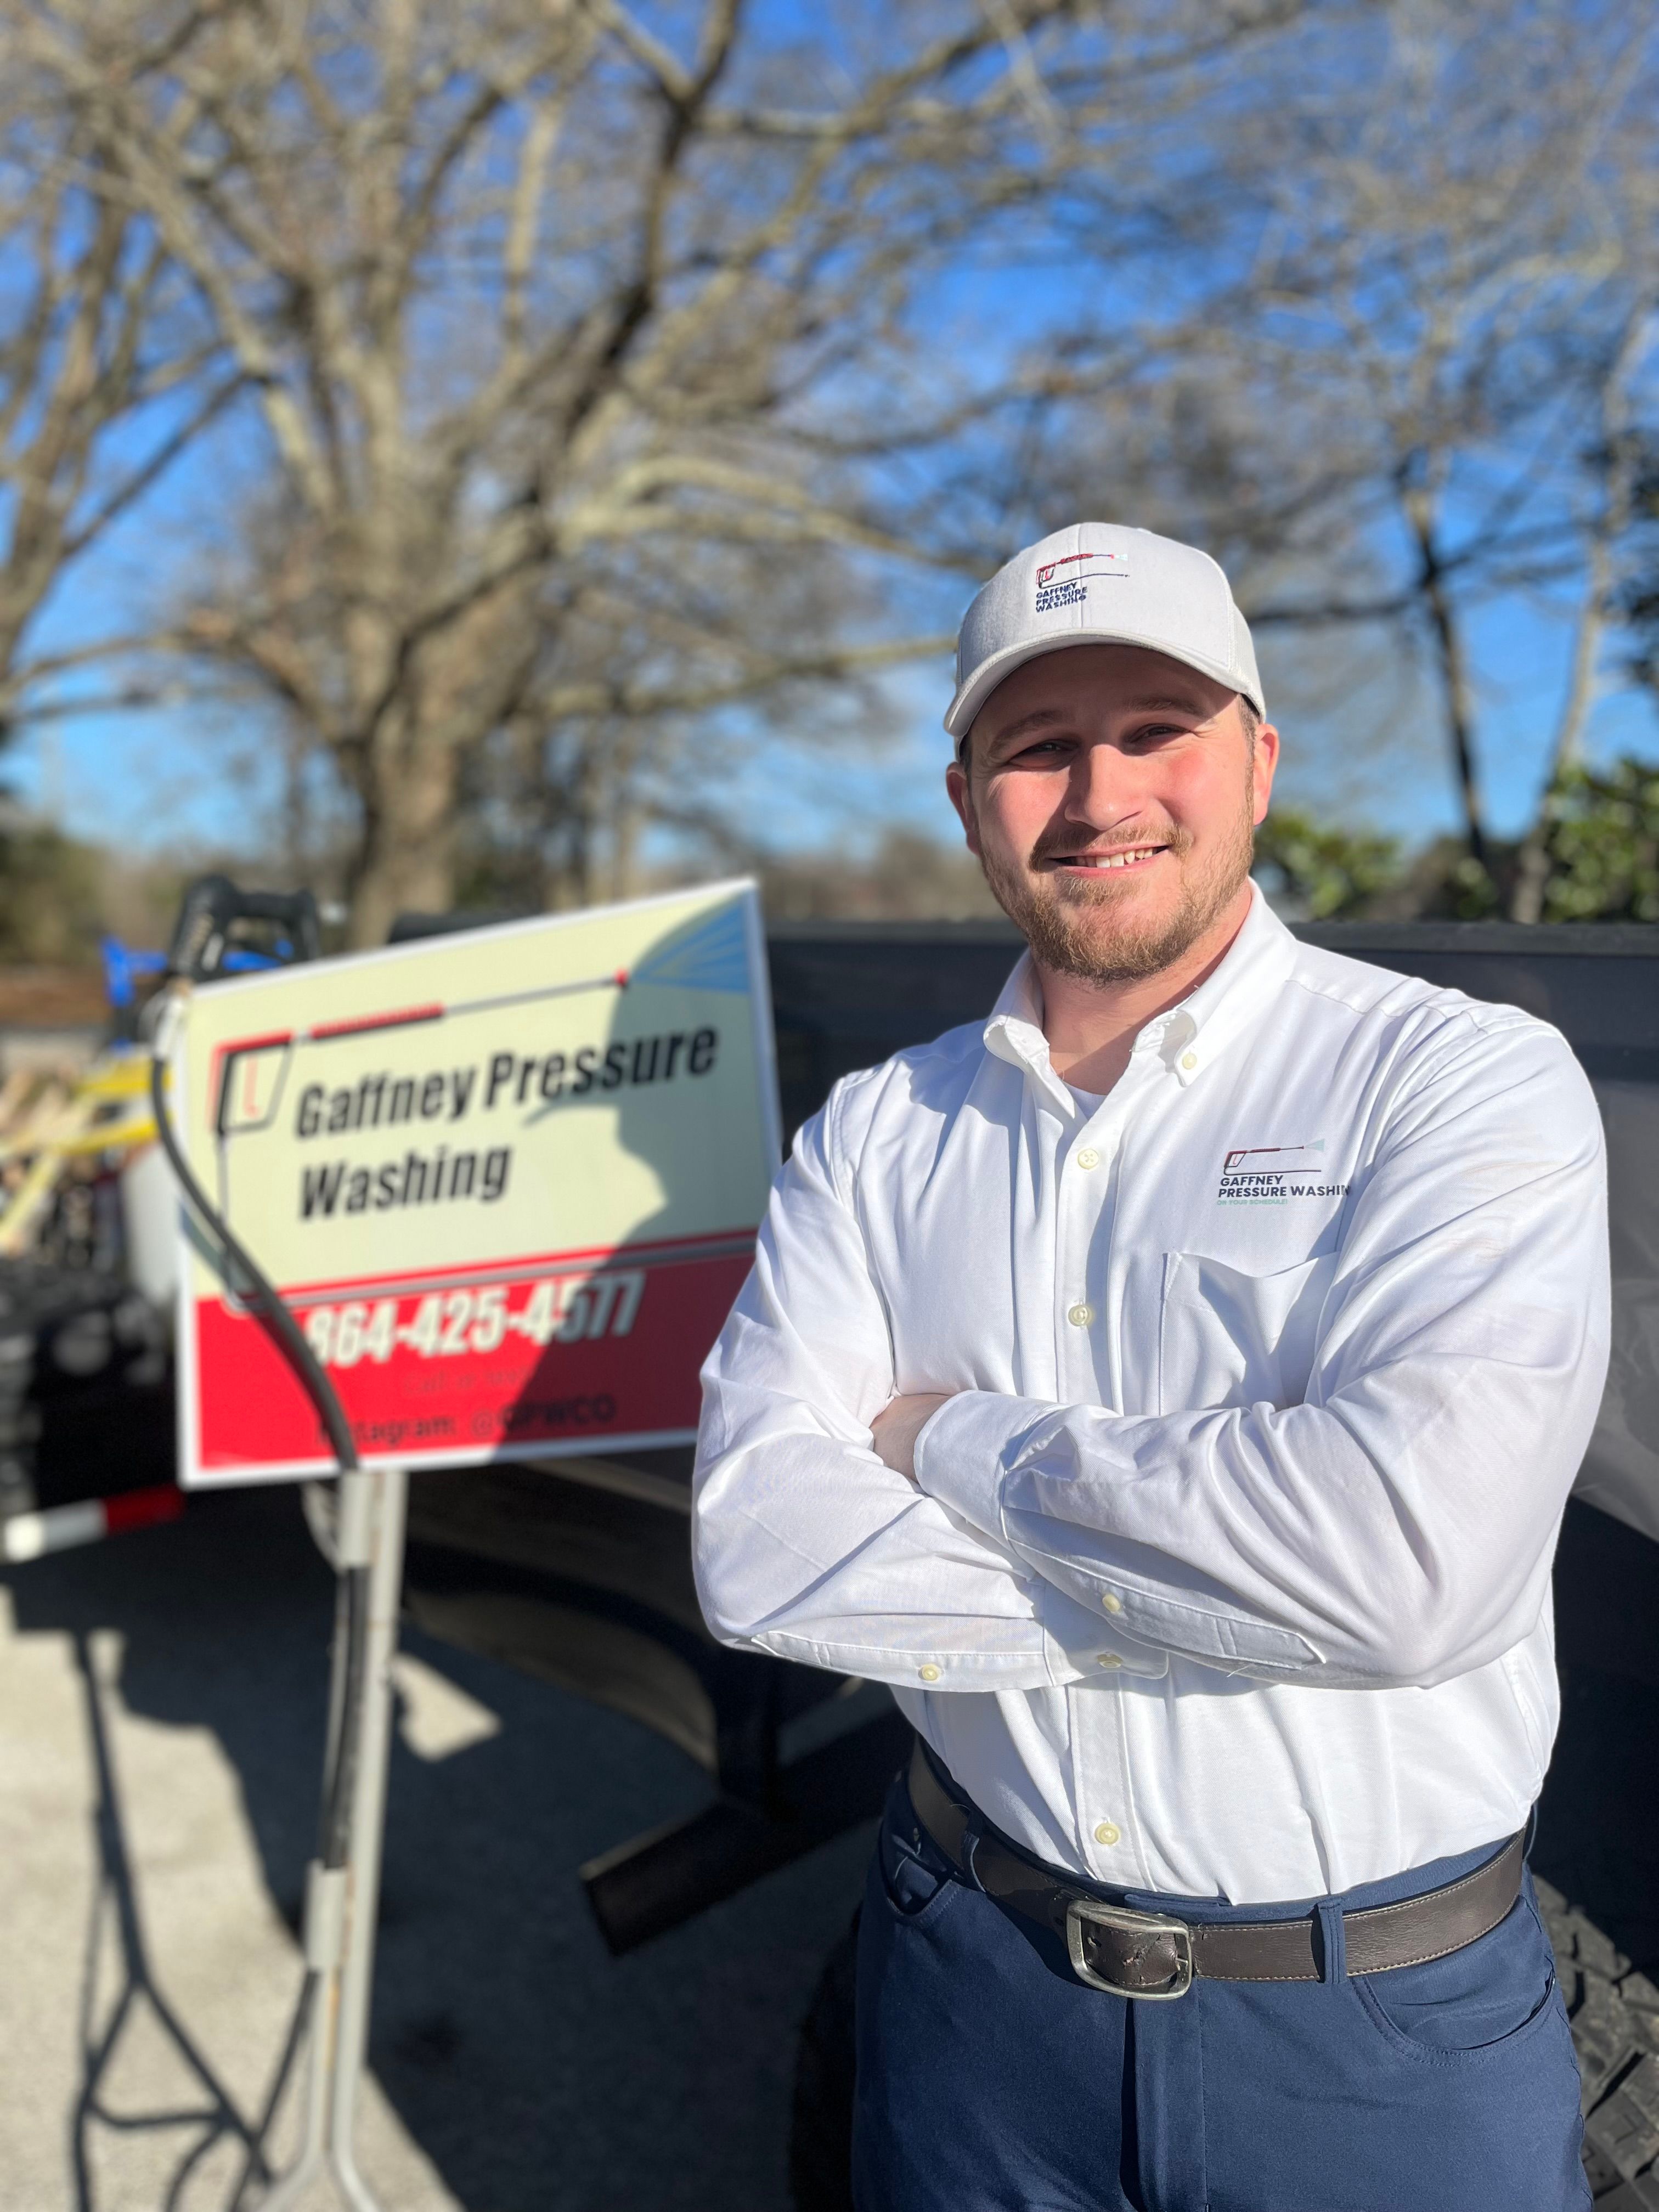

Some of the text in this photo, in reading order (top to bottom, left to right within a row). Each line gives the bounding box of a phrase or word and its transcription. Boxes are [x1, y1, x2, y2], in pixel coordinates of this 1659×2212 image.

[1036, 582, 1077, 599] GAFFNEY
[1036, 586, 1087, 606] PRESSURE
[1036, 595, 1087, 613] WASHING
[296, 1025, 719, 1139] Gaffney Pressure
[300, 1144, 511, 1221] Washing
[1220, 1175, 1283, 1187] GAFFNEY
[1218, 1185, 1351, 1198] PRESSURE WASHIN
[305, 1269, 646, 1368] 864-425-4577
